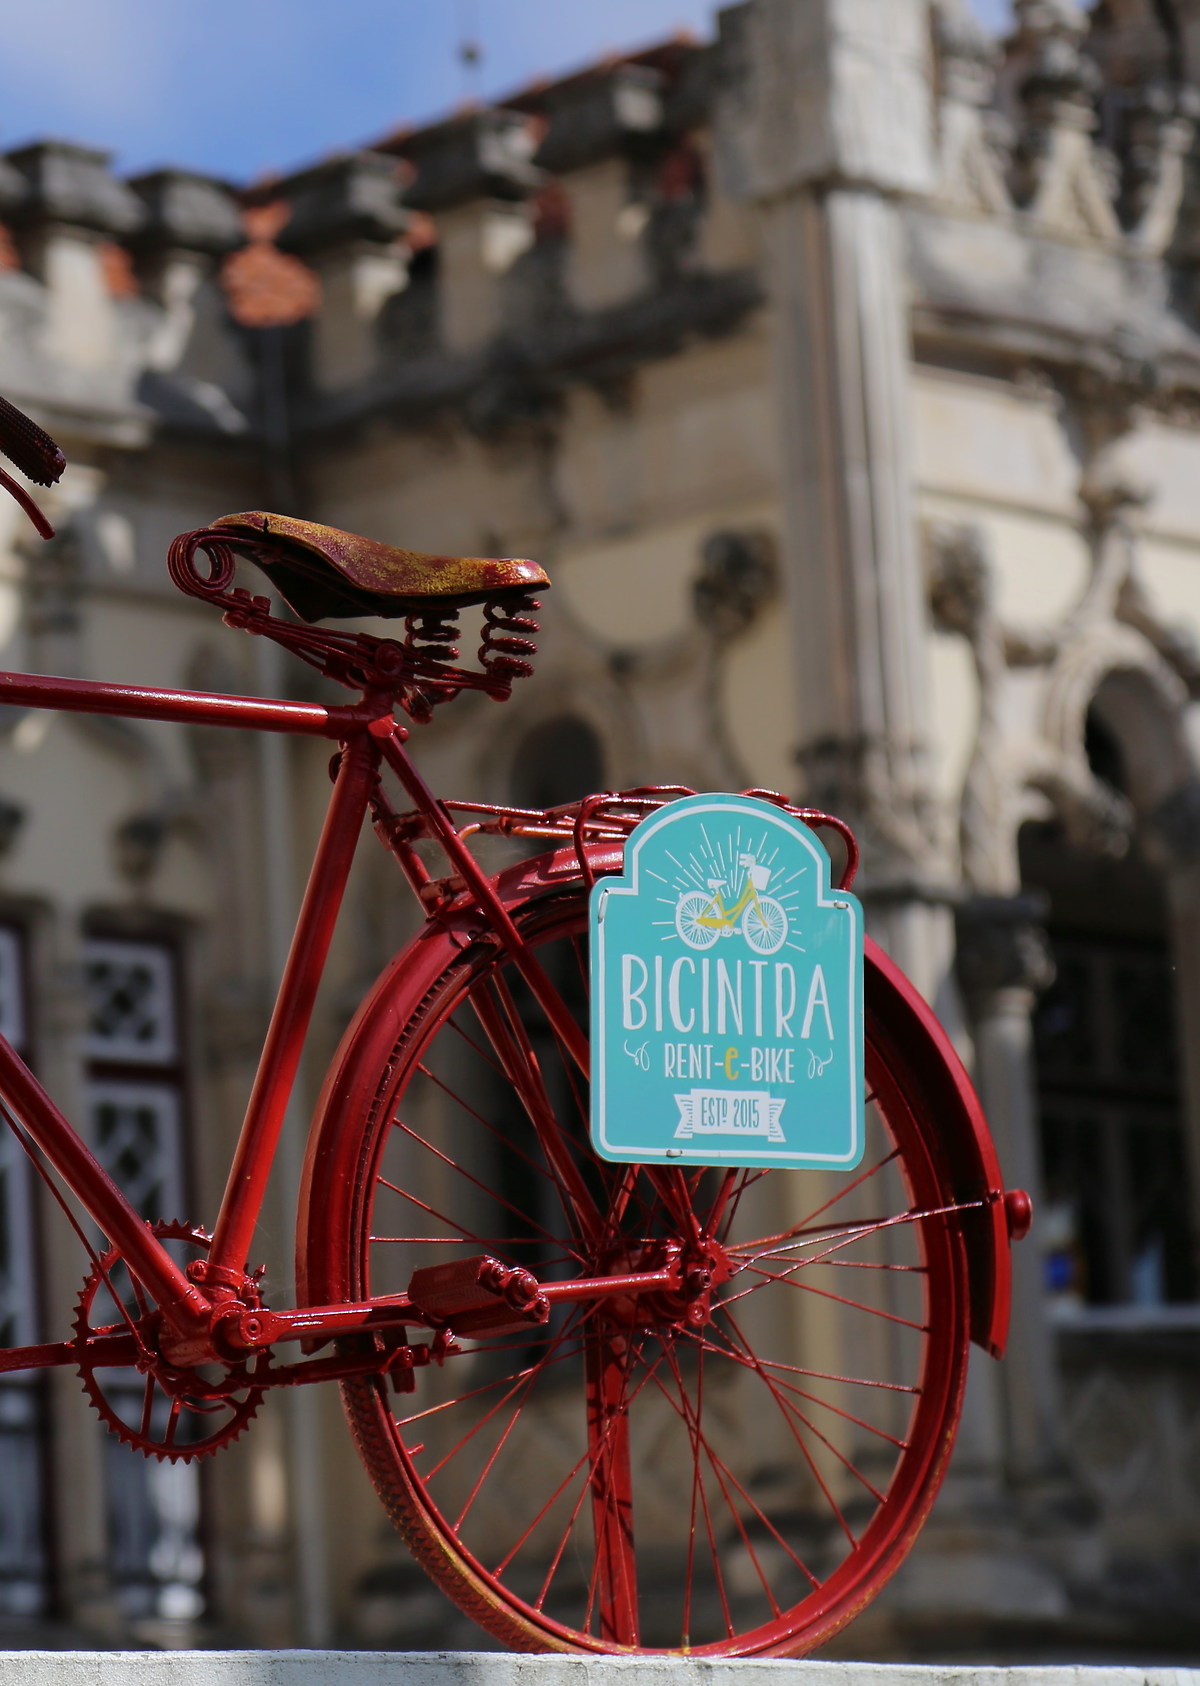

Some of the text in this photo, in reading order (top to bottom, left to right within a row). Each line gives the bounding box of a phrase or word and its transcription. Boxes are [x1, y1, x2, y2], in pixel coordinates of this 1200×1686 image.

[622, 954, 834, 1040] BICINTRA
[665, 1043, 795, 1083] RENT-e-BIKE
[733, 1099, 760, 1128] 2015
